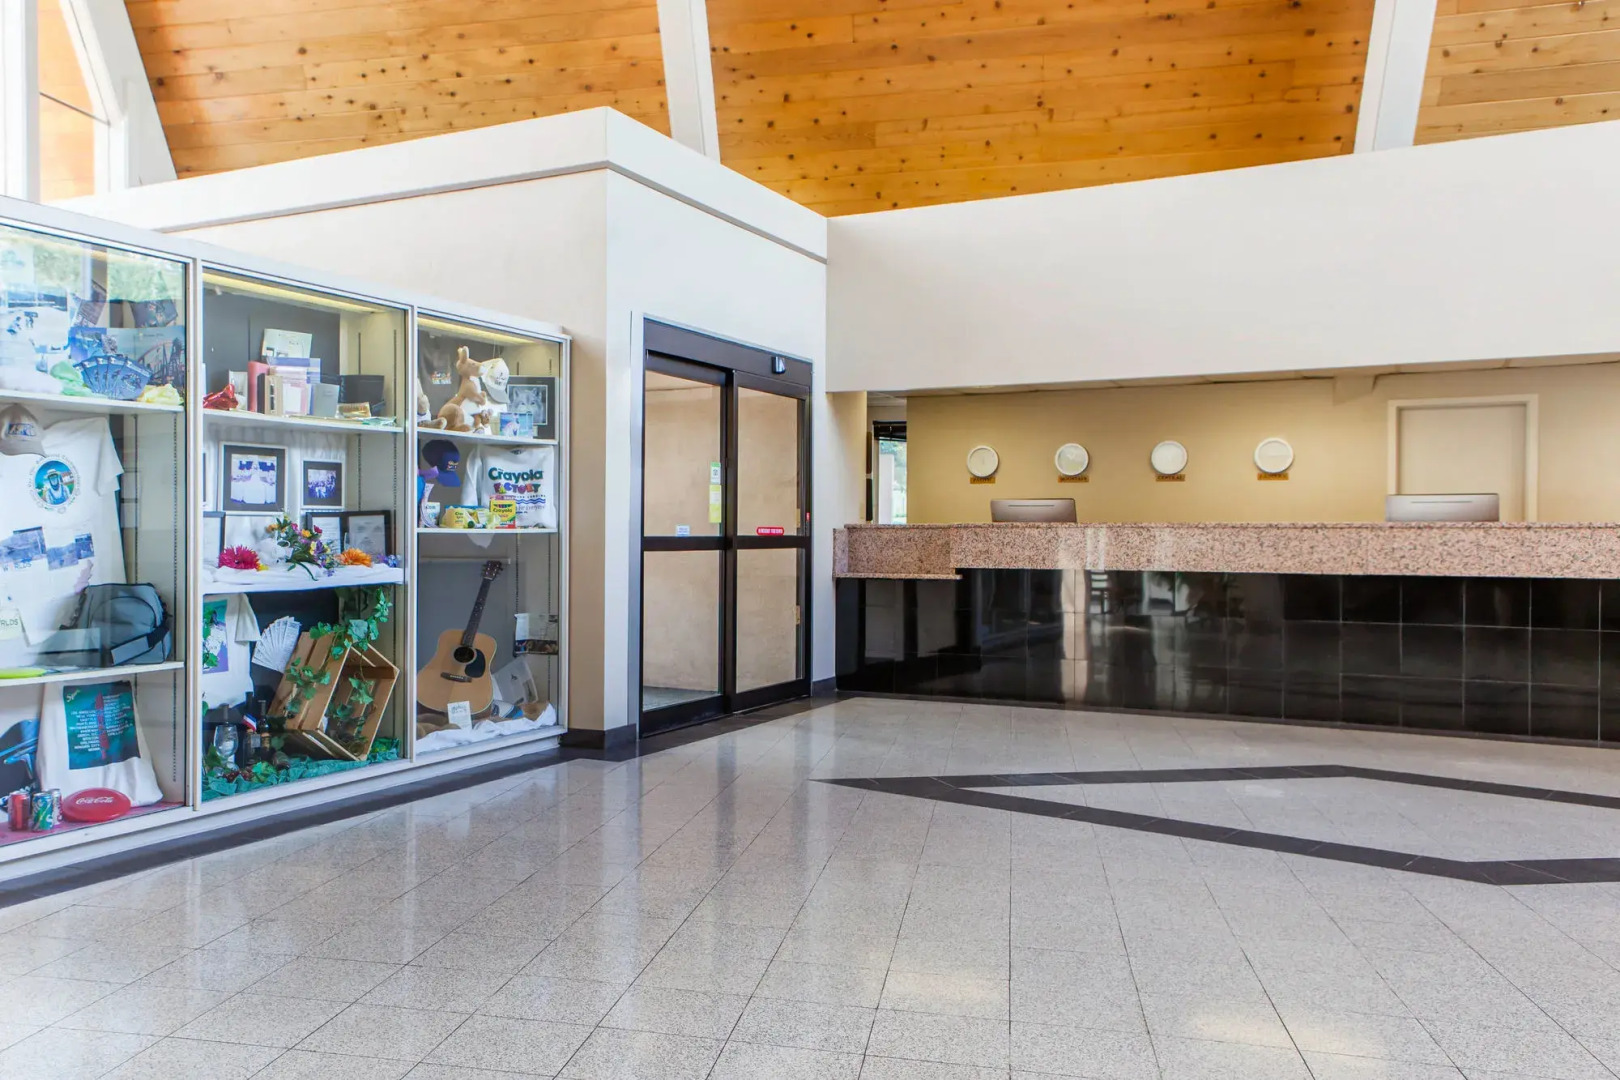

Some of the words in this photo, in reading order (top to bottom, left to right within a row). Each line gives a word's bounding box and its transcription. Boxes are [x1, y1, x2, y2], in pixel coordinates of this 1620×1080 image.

[488, 467, 544, 484] Crayola
[493, 482, 541, 494] FACTORY
[75, 796, 114, 805] Coca-Cola
